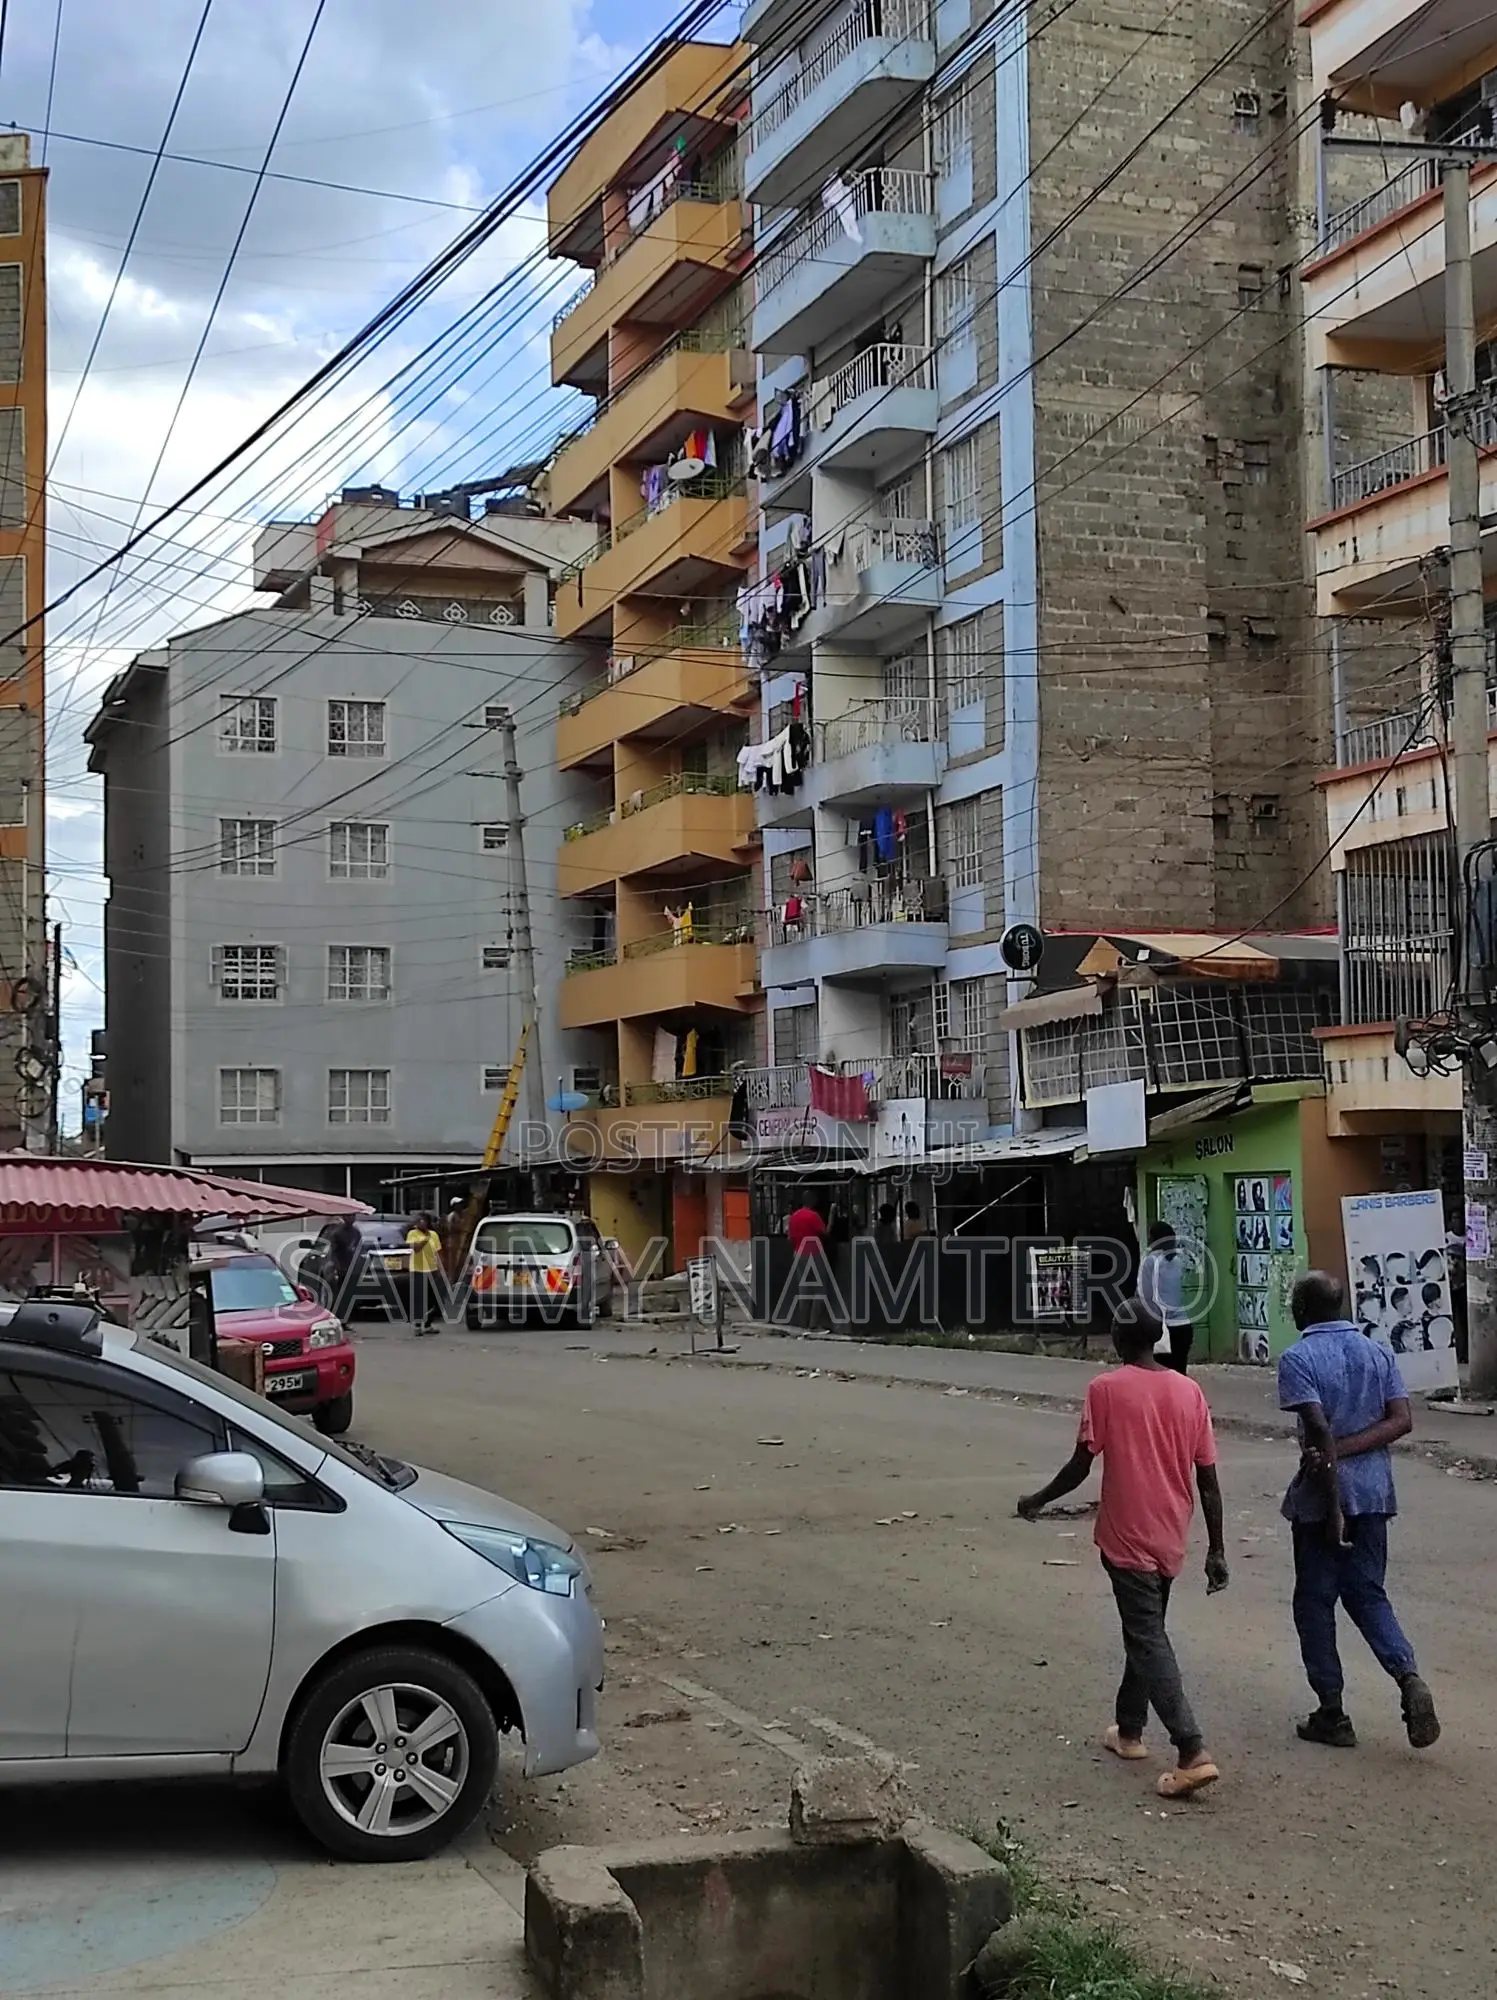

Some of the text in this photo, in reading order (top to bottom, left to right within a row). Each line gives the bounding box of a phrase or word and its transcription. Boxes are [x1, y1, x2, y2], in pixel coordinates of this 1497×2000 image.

[1020, 932, 1031, 967] TUBORG
[1195, 1133, 1234, 1160] SALON
[1384, 1193, 1436, 1208] BARBERS
[271, 1376, 301, 1390] 295W
